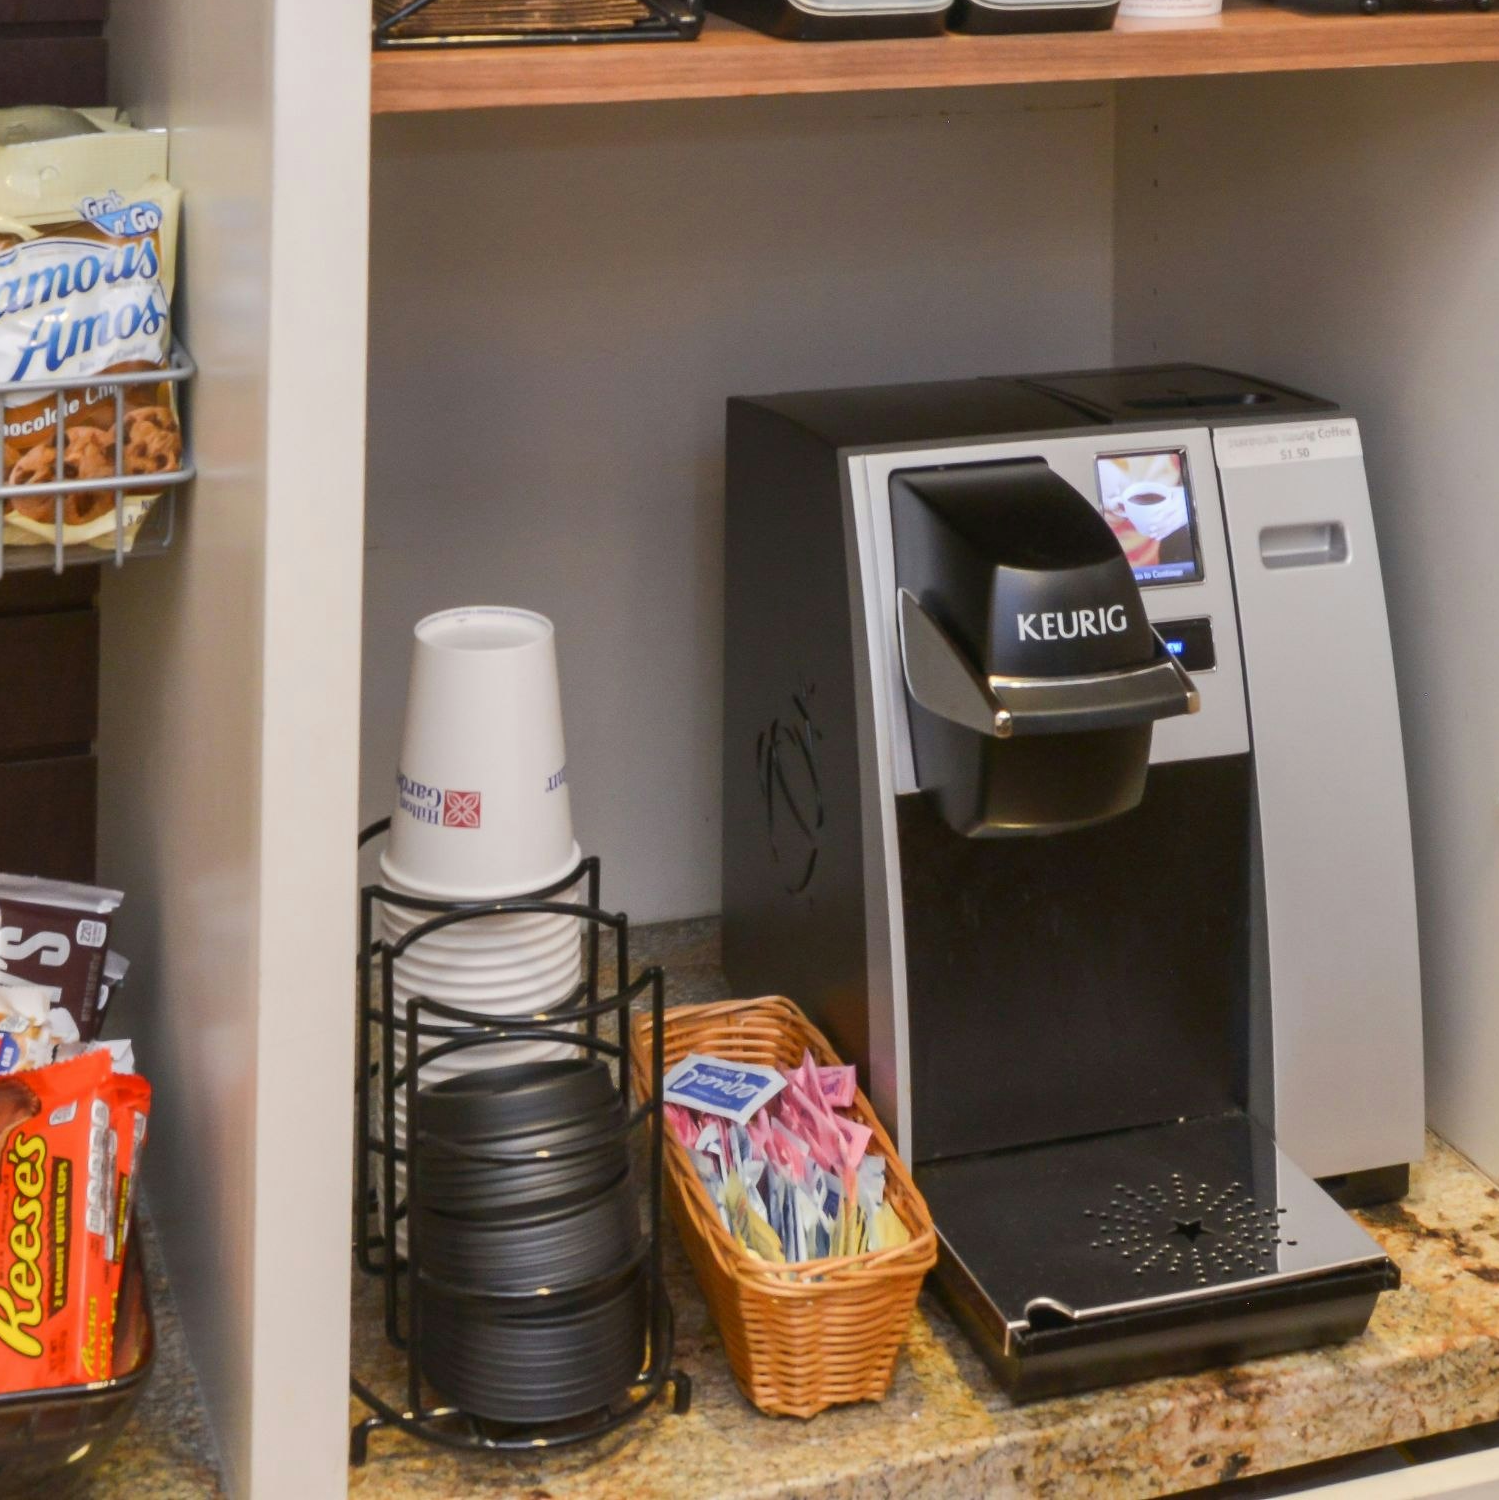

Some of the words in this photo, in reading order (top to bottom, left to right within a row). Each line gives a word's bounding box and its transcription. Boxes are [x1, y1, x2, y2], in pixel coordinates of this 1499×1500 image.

[130, 207, 159, 231] Go
[10, 295, 167, 382] Amos
[1318, 427, 1351, 439] Coffee
[1017, 604, 1128, 641] KEURIG
